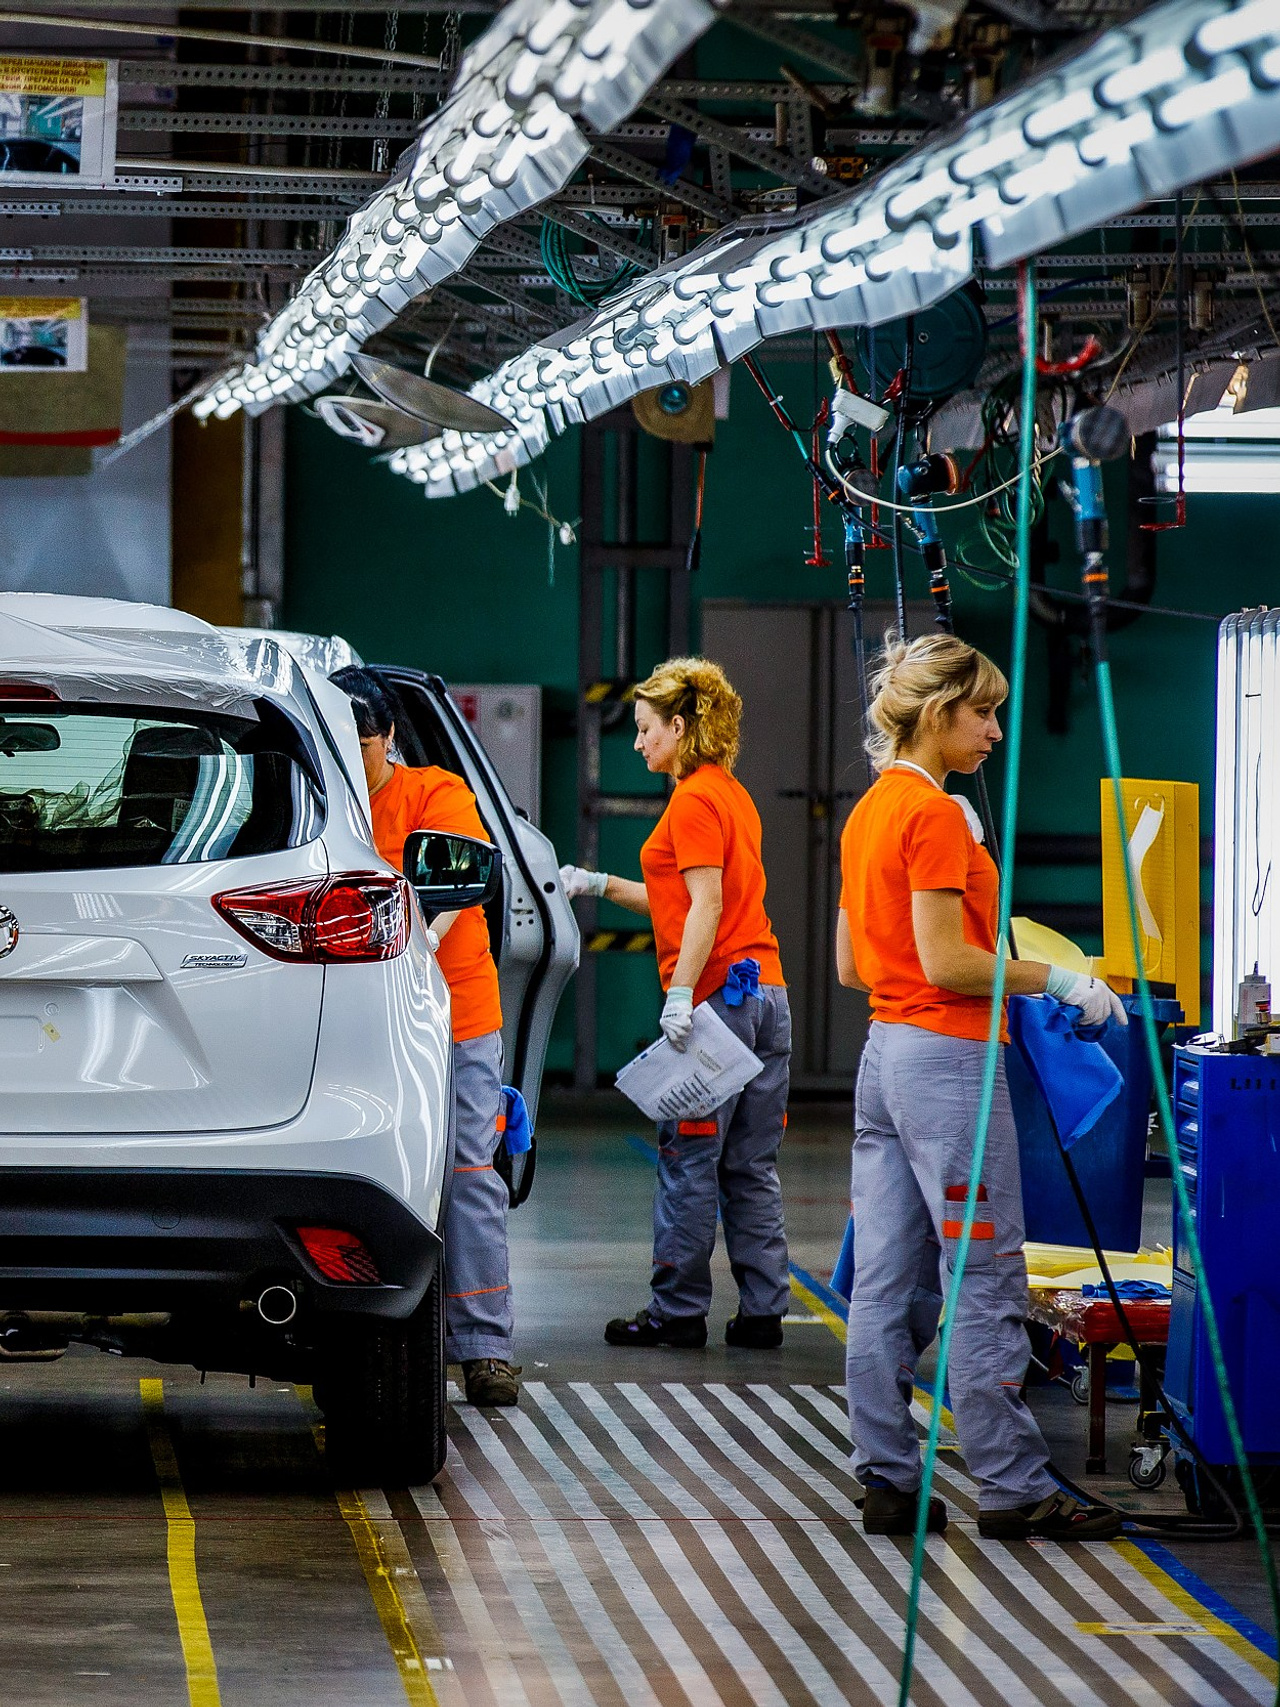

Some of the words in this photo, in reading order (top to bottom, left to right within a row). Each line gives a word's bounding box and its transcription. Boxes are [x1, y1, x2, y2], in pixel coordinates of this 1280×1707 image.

[24, 59, 61, 67] НАЧАЛОМ
[62, 60, 104, 69] ДВИЖЕНИЯ
[71, 78, 91, 86] ПУТИ
